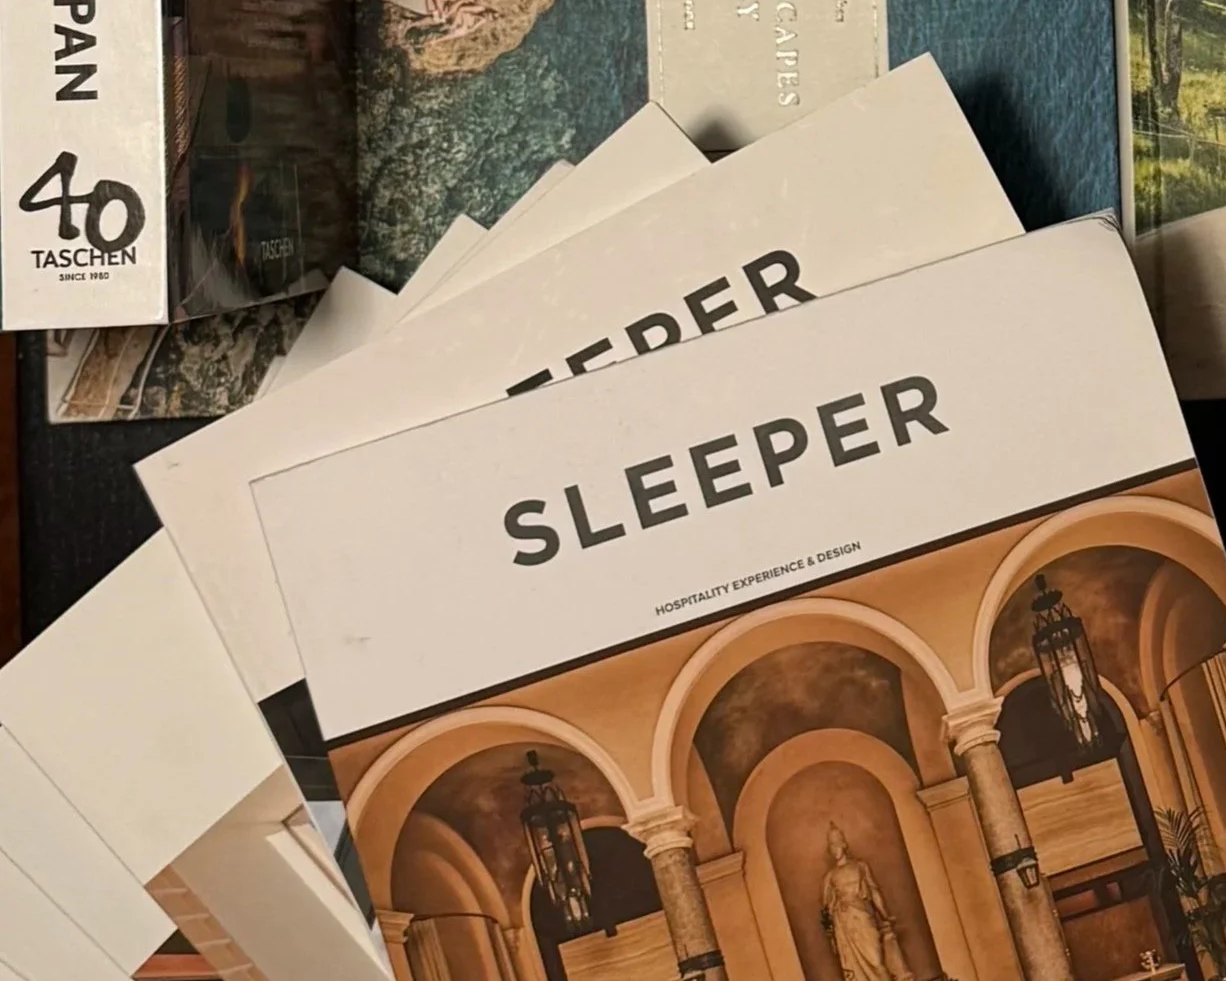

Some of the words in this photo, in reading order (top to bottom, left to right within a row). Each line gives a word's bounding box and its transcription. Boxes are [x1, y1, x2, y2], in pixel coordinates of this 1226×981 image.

[18, 150, 146, 253] 40
[30, 246, 137, 270] TASCHEN
[503, 375, 951, 567] SLEEPER
[655, 581, 731, 617] HOSPITALITY
[732, 558, 806, 591] EXPERIENCE
[806, 555, 816, 567] &
[816, 540, 862, 565] DESIGN
